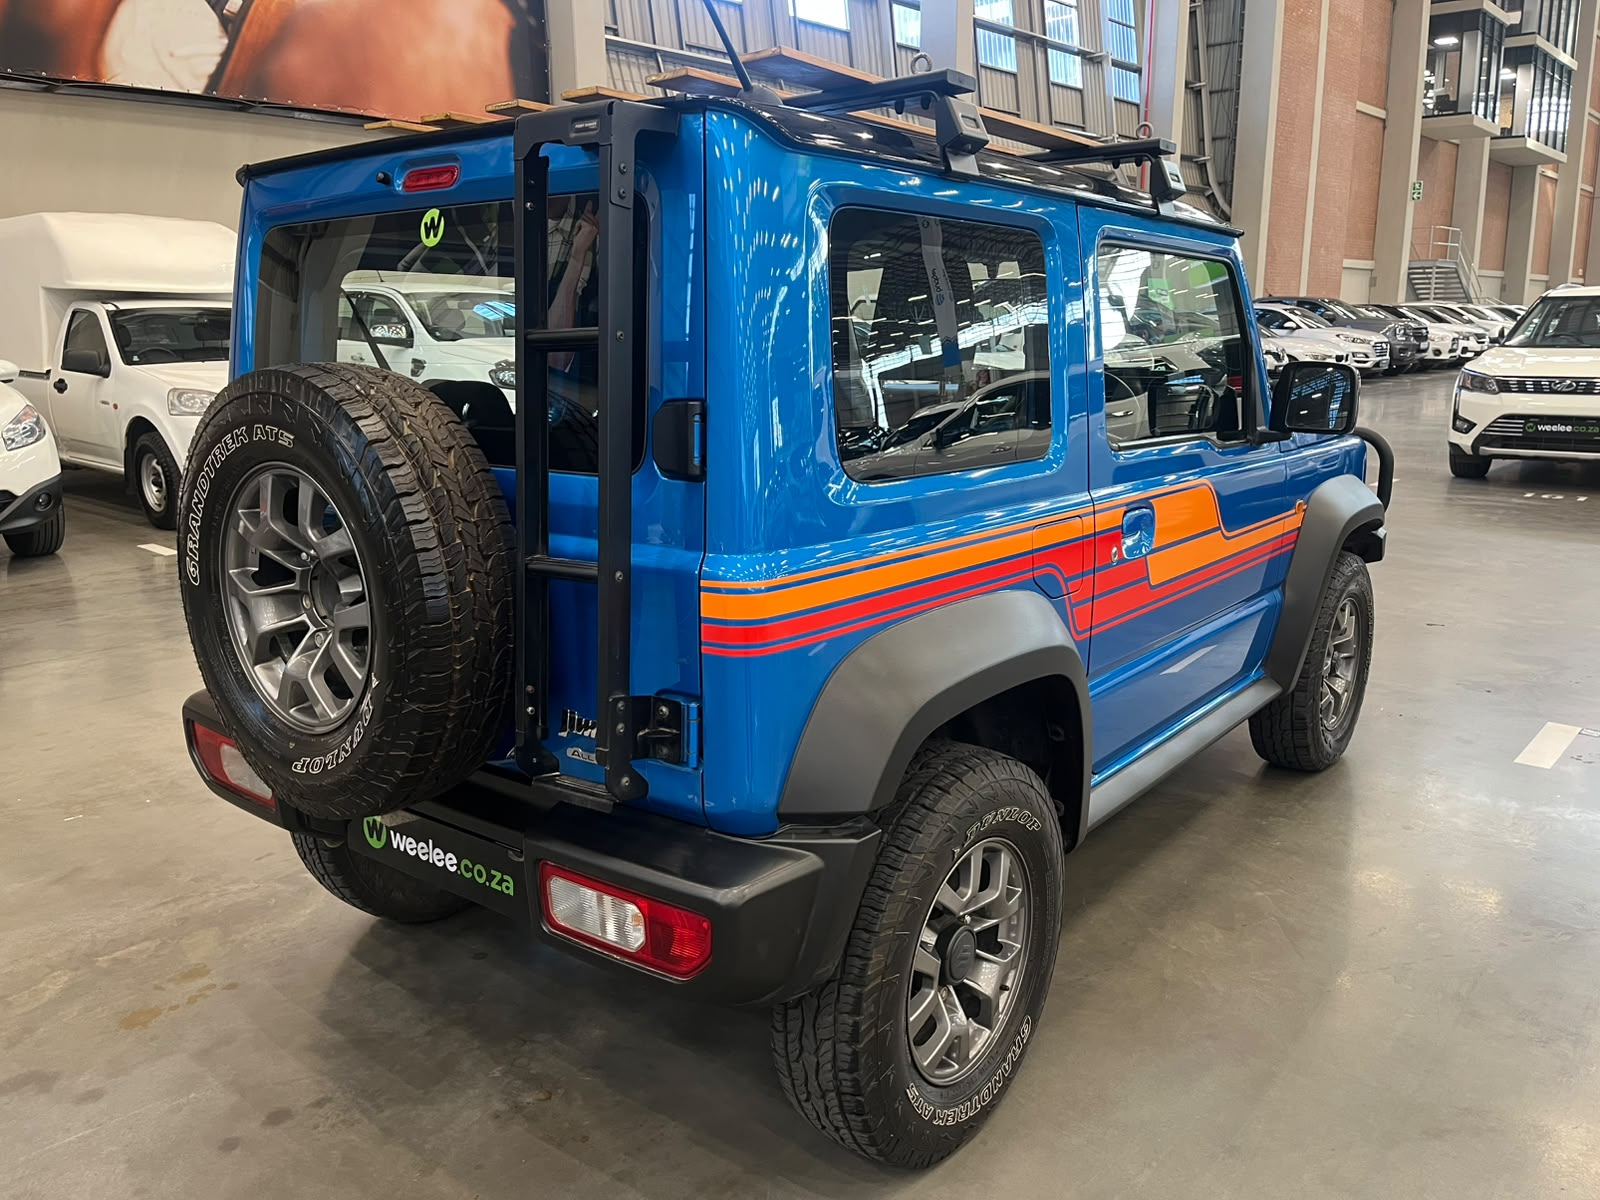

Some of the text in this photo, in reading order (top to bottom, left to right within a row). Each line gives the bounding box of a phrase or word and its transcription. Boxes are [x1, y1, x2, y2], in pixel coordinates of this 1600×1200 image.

[186, 426, 249, 586] GRANDTREK
[291, 692, 374, 774] DUNLOP
[558, 709, 598, 739] Jim
[390, 829, 514, 897] weelee.co.za
[963, 807, 1042, 848] DUNLOP
[932, 1015, 1032, 1126] GRANDTREK
